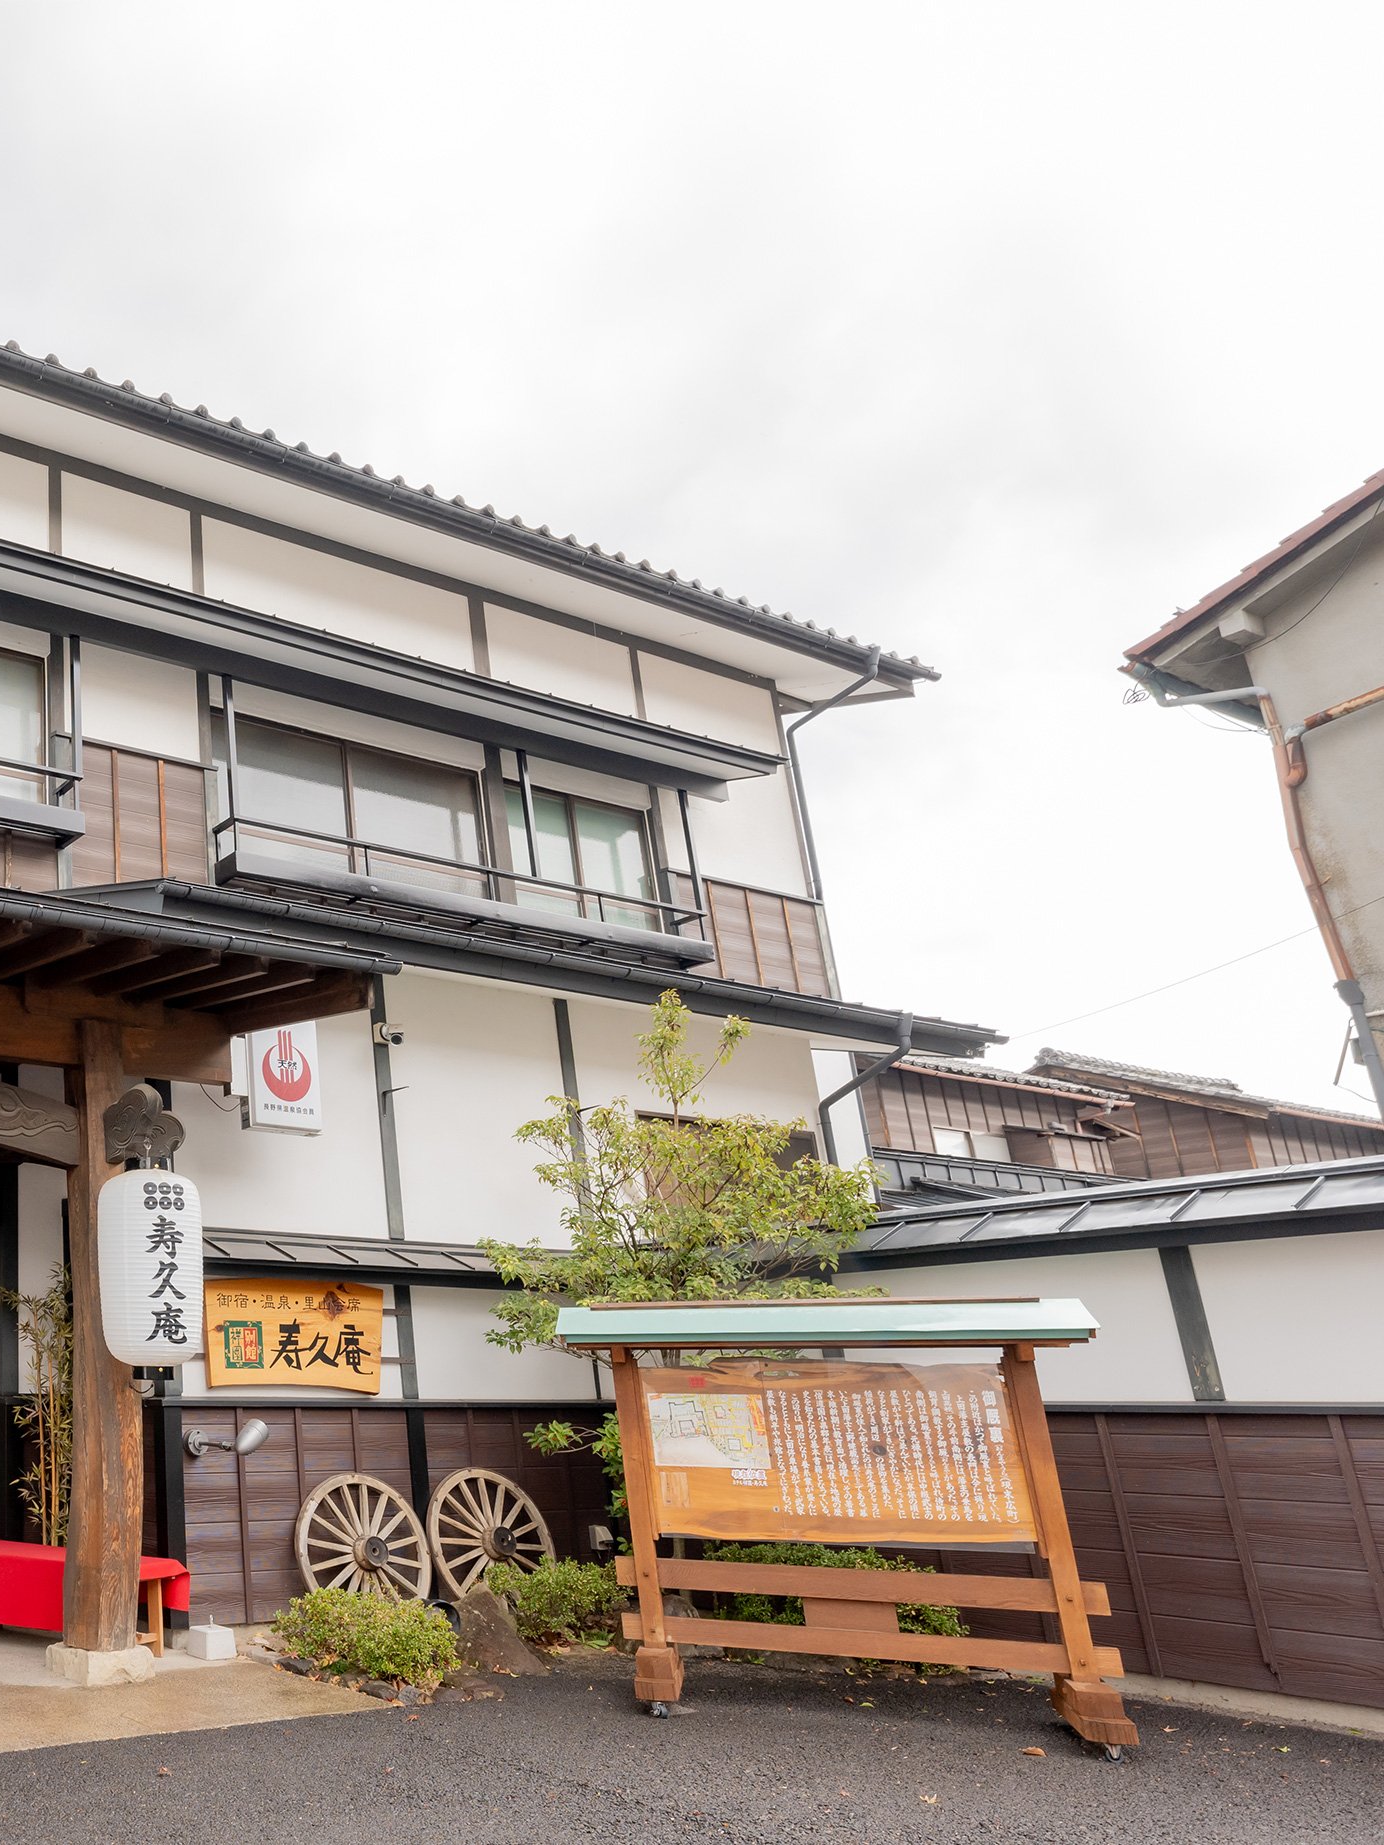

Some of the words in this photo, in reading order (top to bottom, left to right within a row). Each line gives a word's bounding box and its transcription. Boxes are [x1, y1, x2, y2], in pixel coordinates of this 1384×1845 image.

[277, 1058, 298, 1071] 天然
[144, 1214, 189, 1346] 寿久庵
[244, 1328, 257, 1361] 別館
[269, 1318, 374, 1376] 寿久庵
